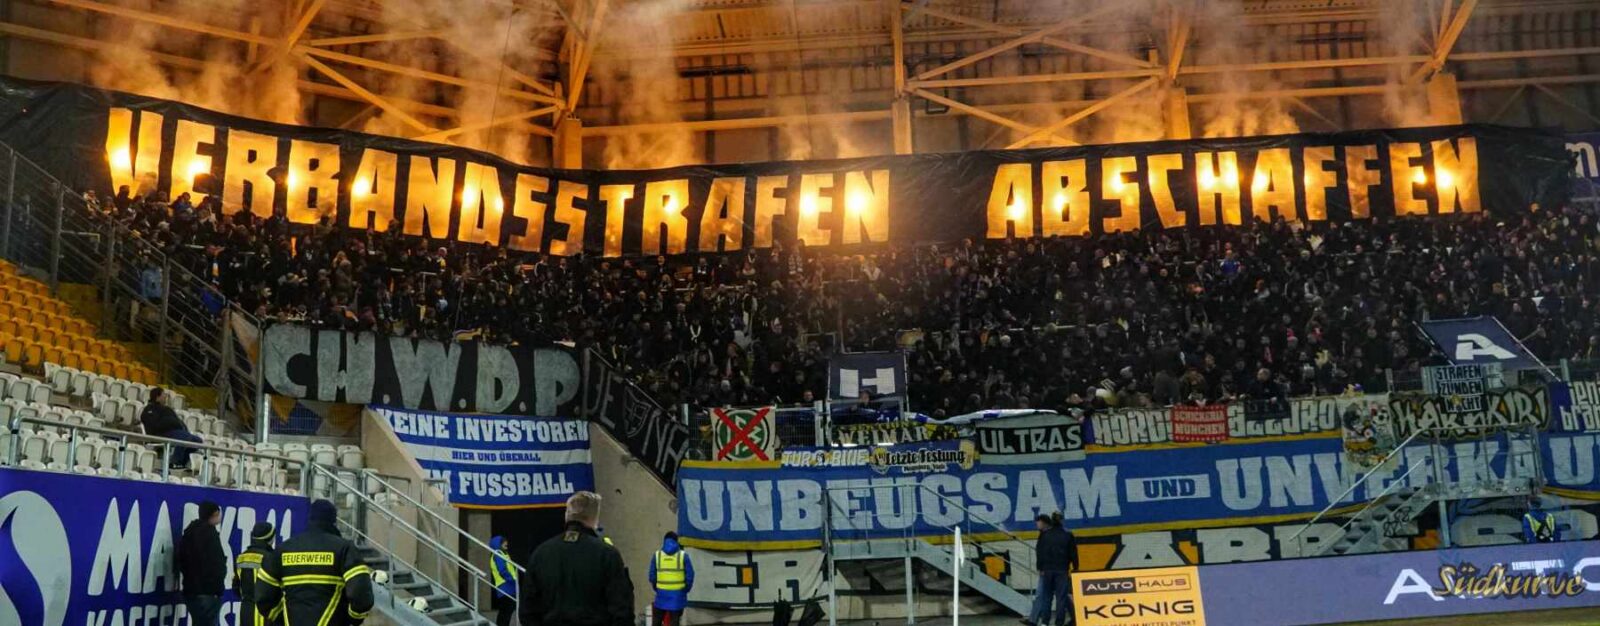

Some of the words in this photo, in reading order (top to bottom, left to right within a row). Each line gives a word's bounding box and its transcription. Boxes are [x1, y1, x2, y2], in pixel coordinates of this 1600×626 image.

[105, 106, 890, 258] VERBANDSSTRAFEN
[986, 136, 1482, 240] ABSCHAFFEN
[1436, 363, 1482, 380] STRAFEN
[1446, 395, 1482, 412] NCHT
[457, 416, 590, 443] INVESTOREN
[980, 425, 1083, 455] ULTRAS
[452, 451, 476, 461] HIER
[478, 453, 497, 462] UND
[458, 470, 574, 497] FUSSBALL
[680, 465, 1119, 533] UNBEUGSAM
[1142, 477, 1196, 498] UND
[282, 552, 333, 566] FEUERWEHR
[1083, 598, 1196, 620] KÖNIG
